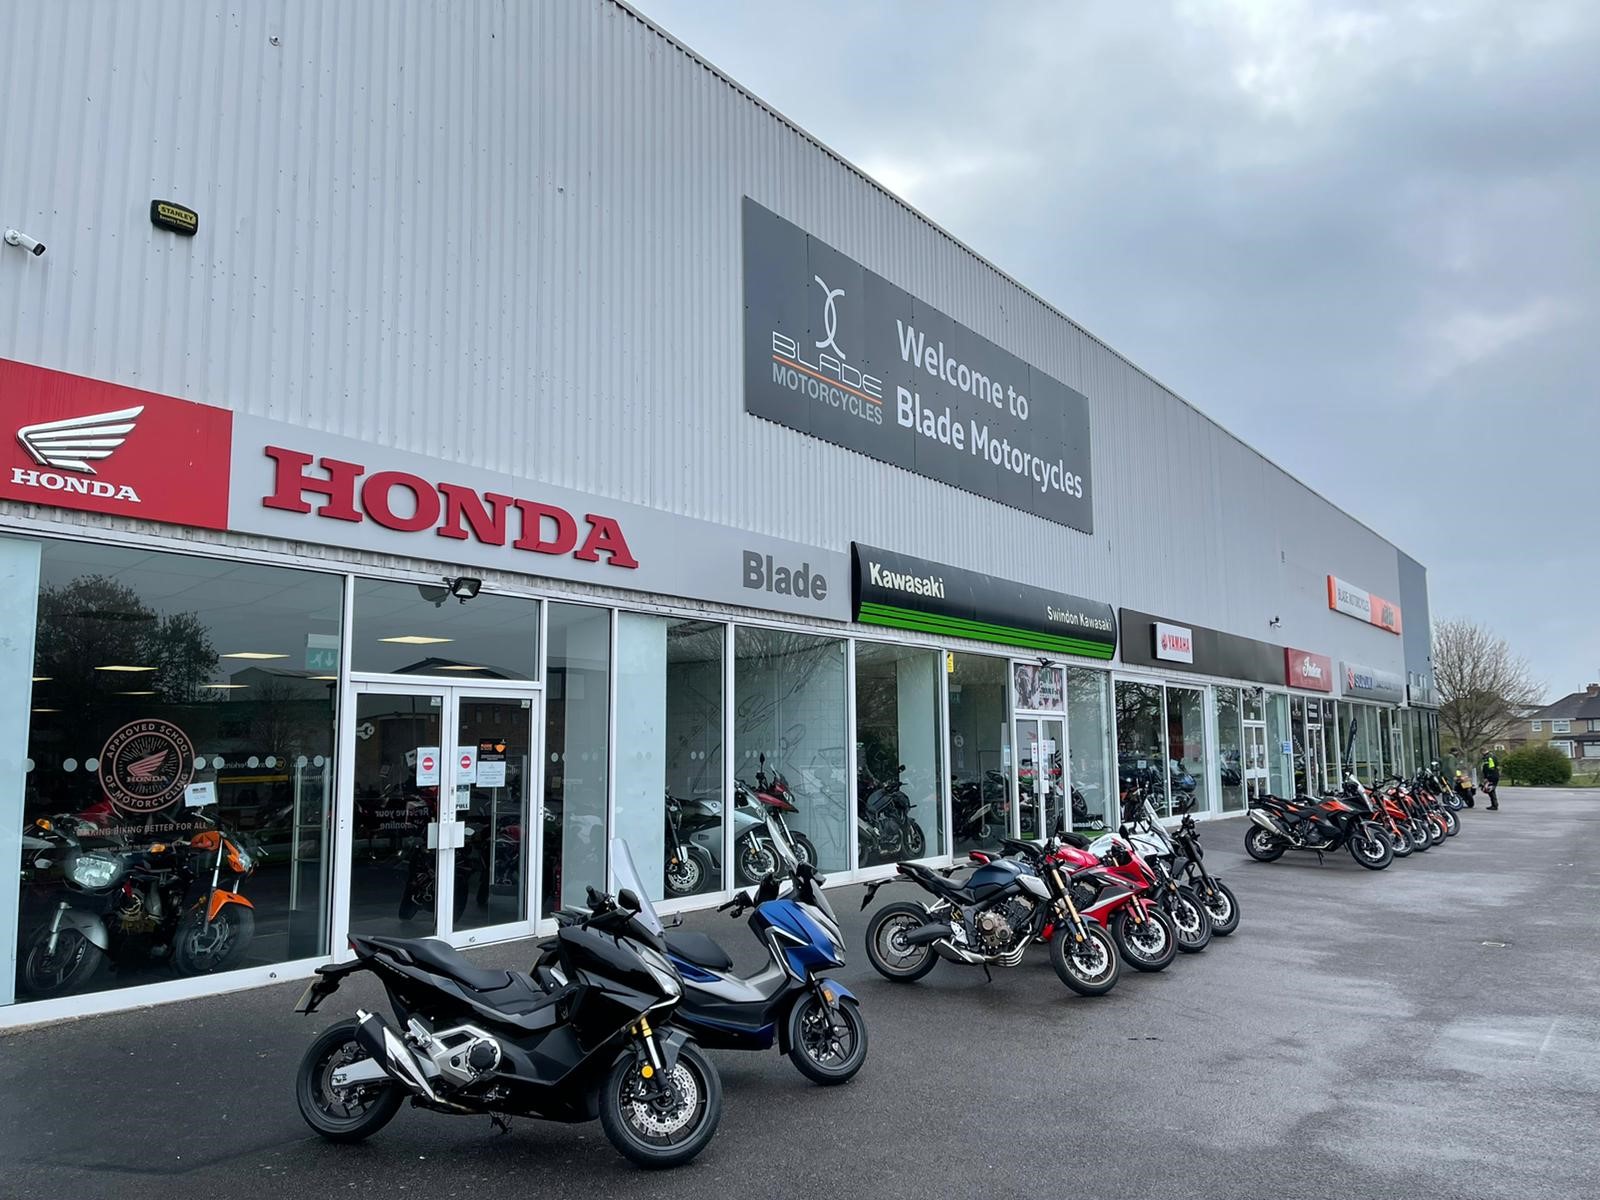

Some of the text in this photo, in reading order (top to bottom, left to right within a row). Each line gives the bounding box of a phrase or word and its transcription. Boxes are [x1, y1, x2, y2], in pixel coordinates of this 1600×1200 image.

[161, 206, 193, 221] STANLEY
[772, 331, 883, 399] BLADE
[896, 319, 1029, 420] Welcome to
[772, 362, 883, 425] MOTORCYCLES
[896, 385, 1083, 499] Blade Motorcycles
[11, 467, 141, 503] HONDA
[262, 445, 639, 569] HONDA
[742, 550, 827, 601] Blade
[869, 561, 945, 599] Kawasaki
[1047, 605, 1112, 633] Swindon Kawasaki
[106, 723, 190, 759] APPROVED SCHOOL
[105, 773, 189, 808] OF MOTORCYCLING
[126, 775, 168, 783] HONDA
[144, 823, 175, 833] BETTER
[176, 822, 191, 831] FOR
[193, 821, 208, 830] ALL
